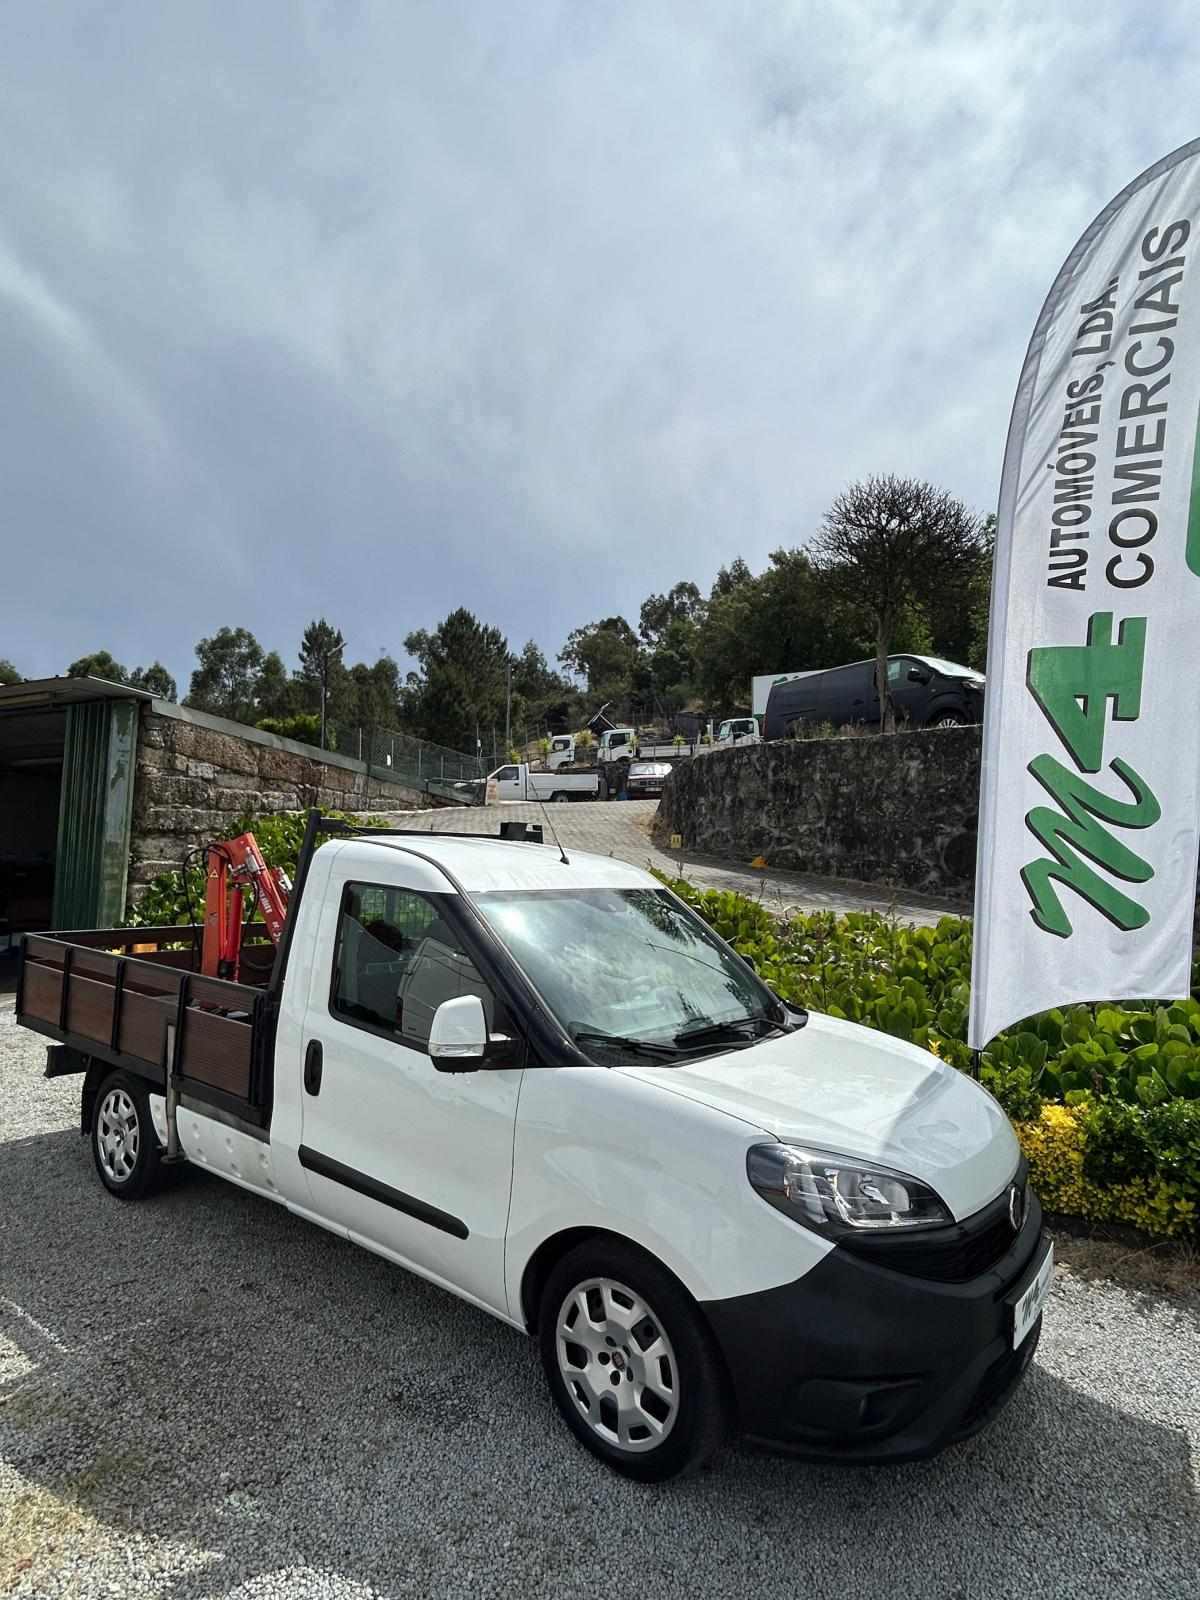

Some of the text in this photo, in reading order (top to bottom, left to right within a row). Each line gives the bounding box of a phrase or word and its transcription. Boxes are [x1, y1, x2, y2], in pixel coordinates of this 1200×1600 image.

[1047, 275, 1120, 591] AUTOMÓVEIS, LDA.
[1105, 218, 1191, 589] COMERCIAIS
